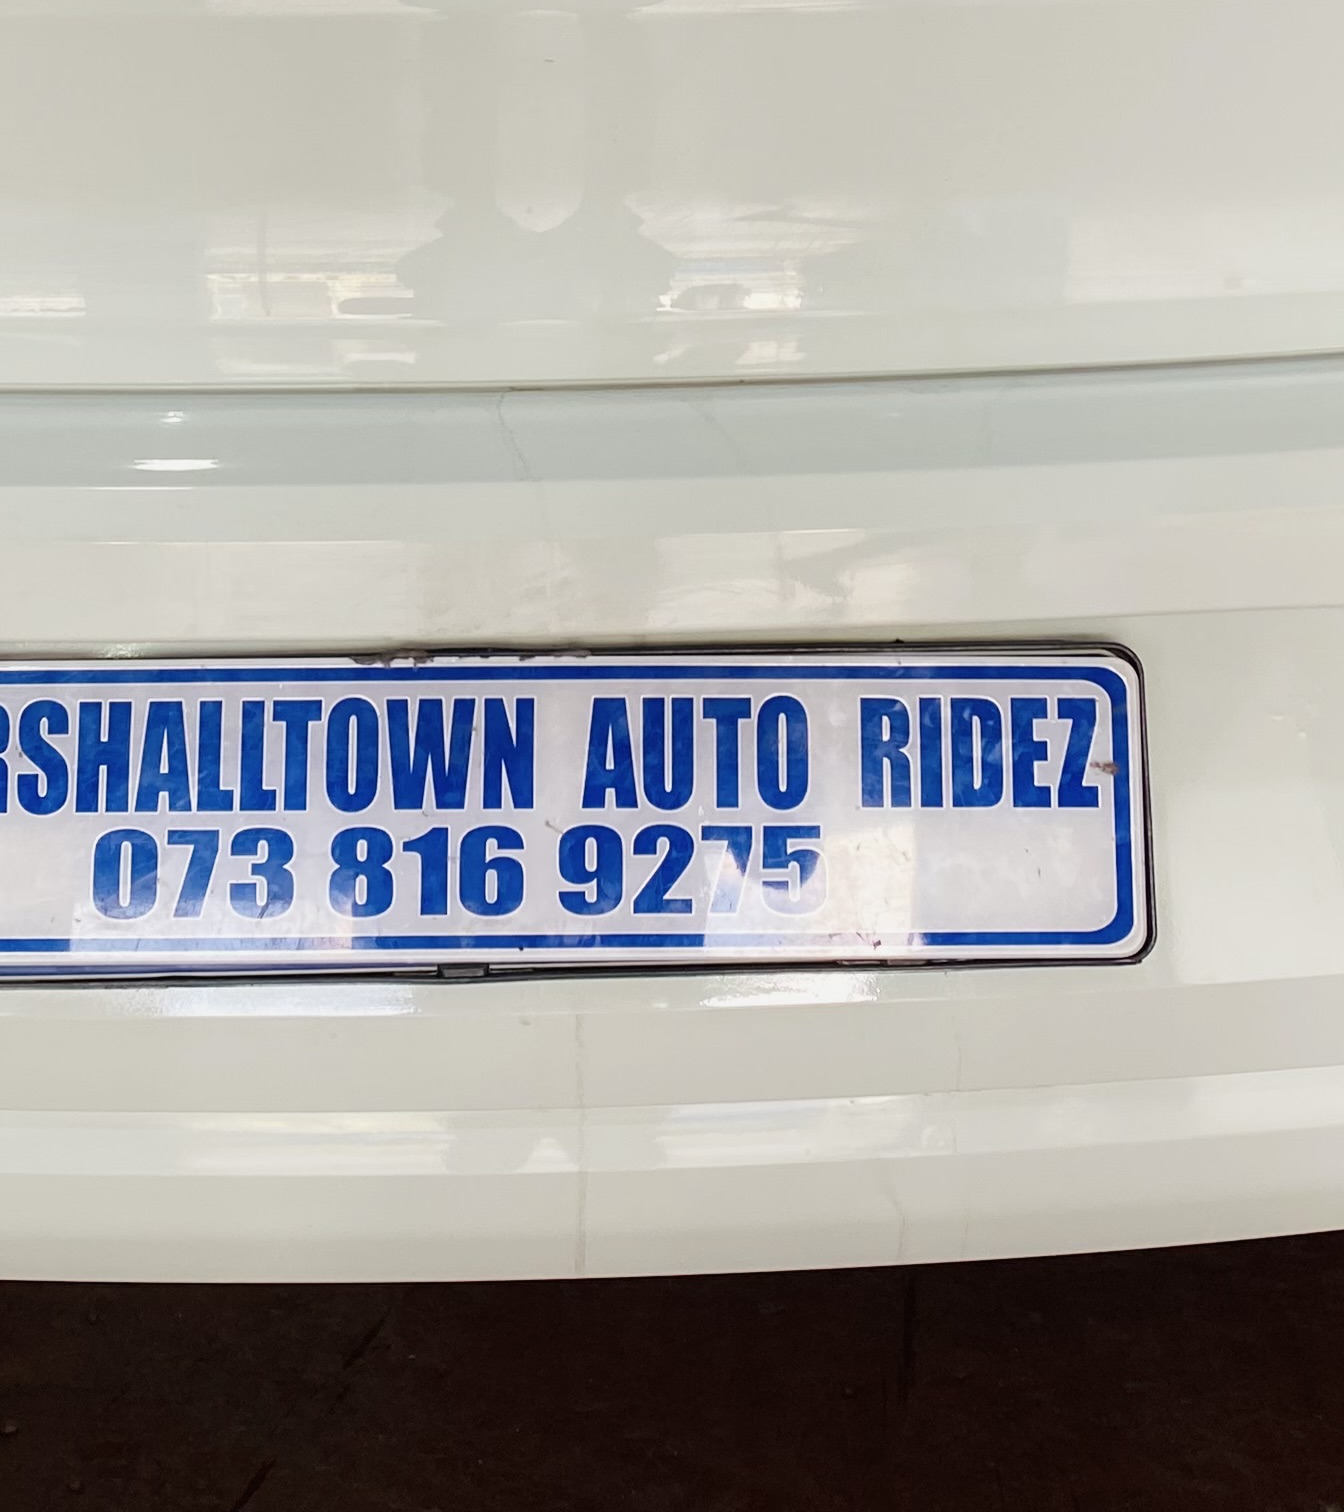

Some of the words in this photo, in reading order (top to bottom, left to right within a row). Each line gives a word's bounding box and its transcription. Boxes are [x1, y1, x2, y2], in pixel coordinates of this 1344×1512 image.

[581, 696, 810, 812] AUTO
[860, 696, 1101, 810] RIDEZ
[93, 827, 296, 918] 073
[328, 826, 526, 918] 816
[558, 823, 827, 916] 9275
